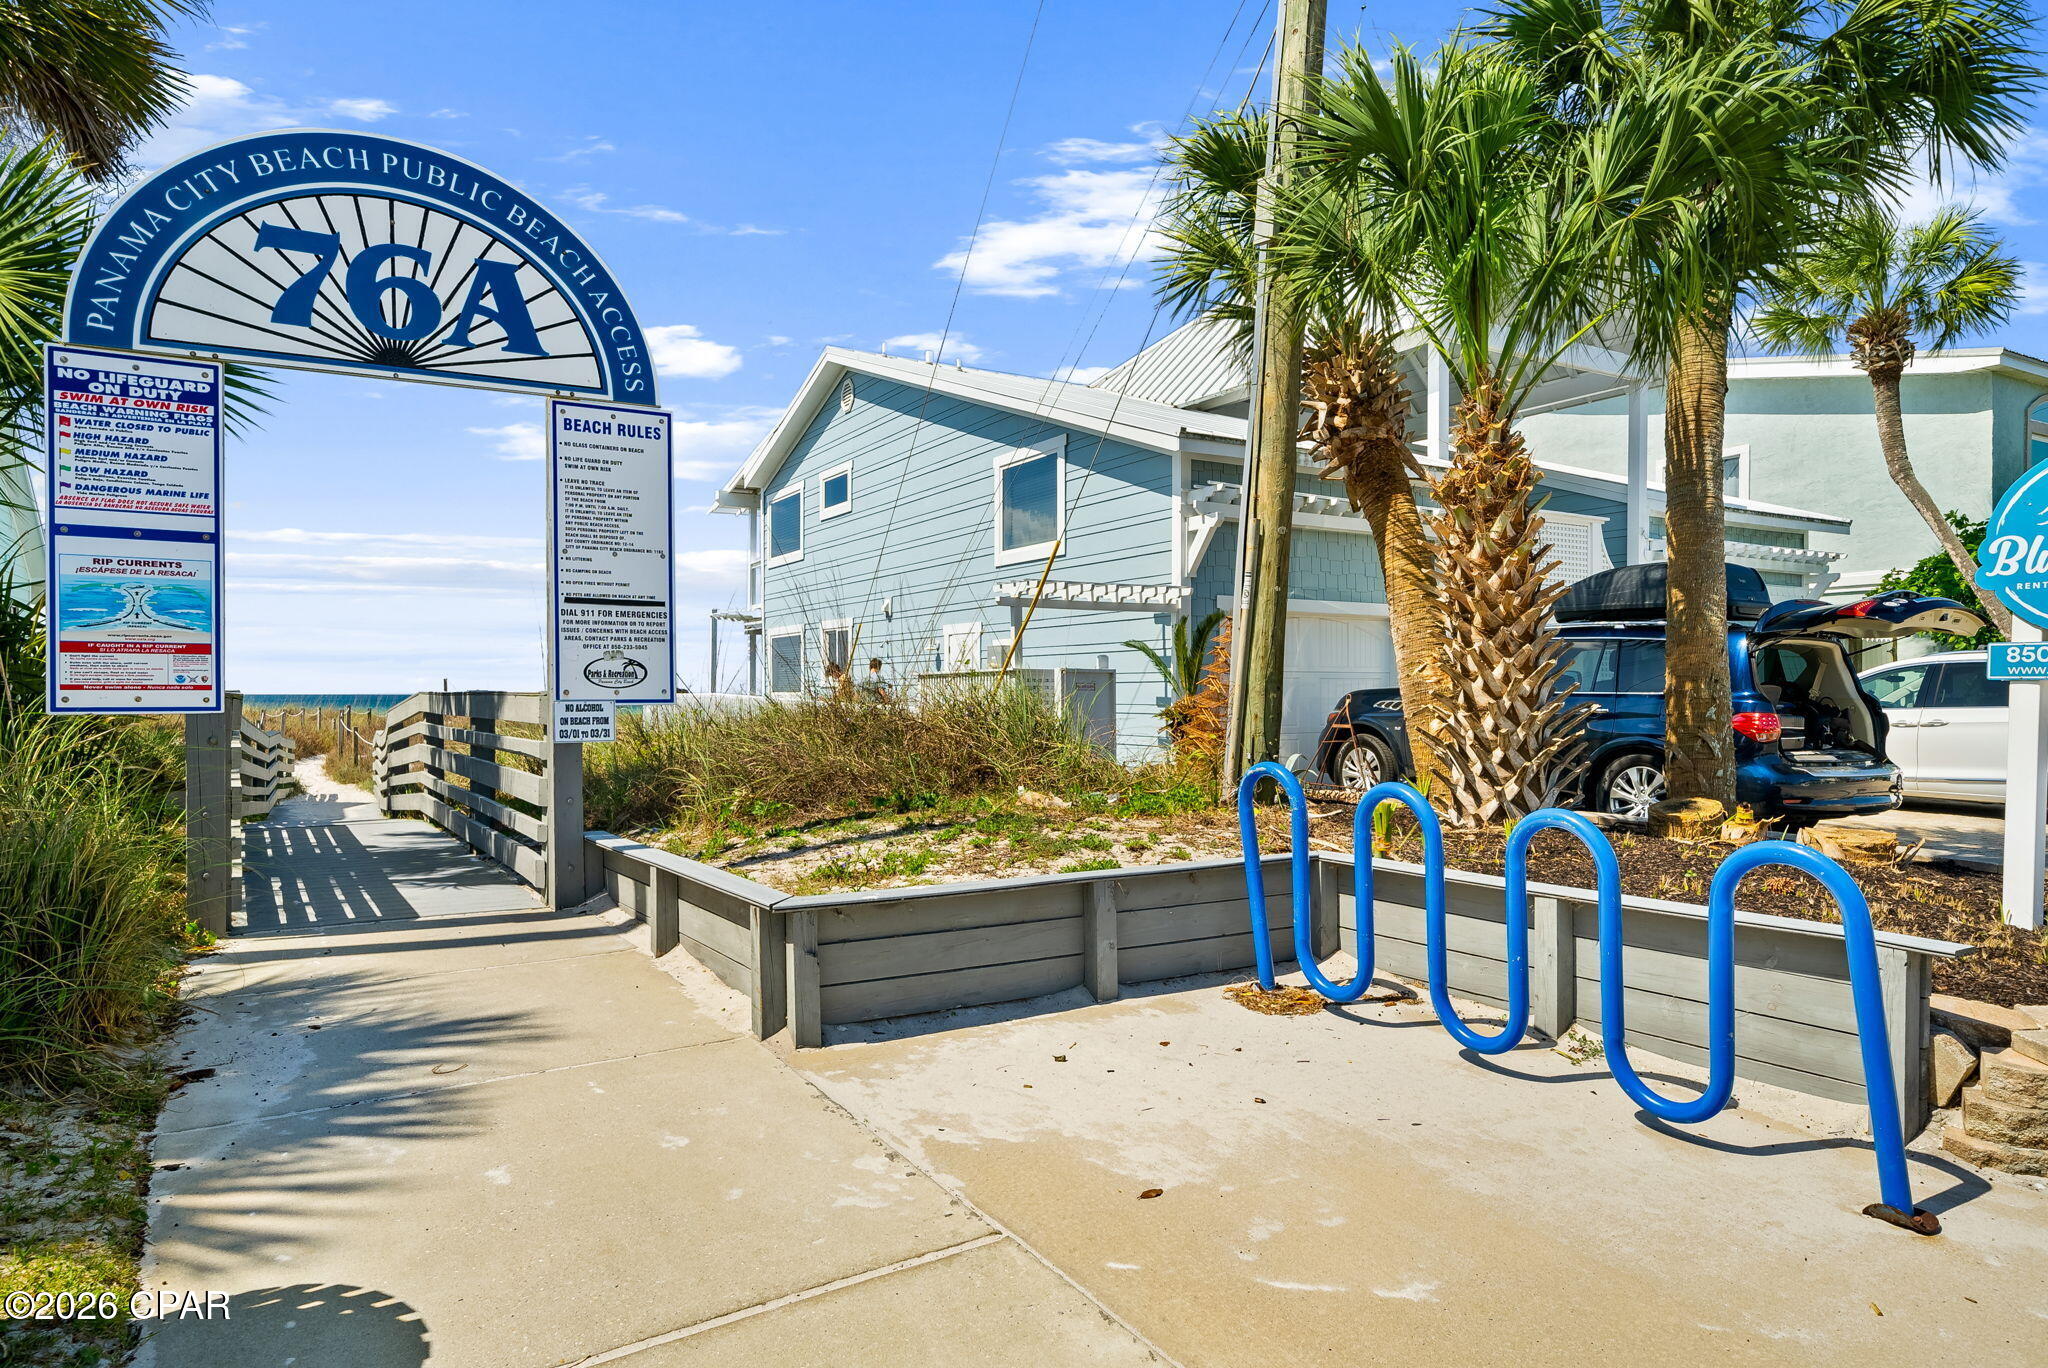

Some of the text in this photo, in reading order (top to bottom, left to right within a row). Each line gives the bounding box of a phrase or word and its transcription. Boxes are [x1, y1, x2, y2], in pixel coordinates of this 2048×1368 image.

[86, 147, 644, 392] PANAMA CITY BEACH PUBLIC BEACH ACCESS
[254, 220, 551, 357] 76A
[57, 367, 210, 394] NO LIFEGUARD
[88, 382, 182, 401] ON DUTY
[60, 392, 209, 414] SWIM AT OWN RISK
[54, 401, 213, 423] BEACH WARNING FLAGS
[74, 418, 111, 428] WATER
[116, 422, 154, 432] CLOSED
[176, 427, 210, 437] PUBLIC
[563, 418, 661, 440] BEACH RULES
[73, 432, 100, 441] HIGH
[105, 435, 149, 445] HAZARD
[75, 448, 120, 458] MEDIUM
[125, 452, 168, 462] HAZARD
[75, 466, 100, 474] LOW
[104, 468, 148, 478] HAZARD
[75, 484, 141, 495] DANGEROUS
[145, 489, 186, 498] MARINE
[117, 559, 182, 569] CURRENTS
[615, 610, 668, 620] EMERGENCIES
[588, 670, 602, 678] Parks
[565, 704, 604, 712] NO ALCOHOL
[560, 716, 609, 726] ON BEACH FROM
[560, 730, 580, 738] 03/01
[590, 728, 610, 738] 03/31
